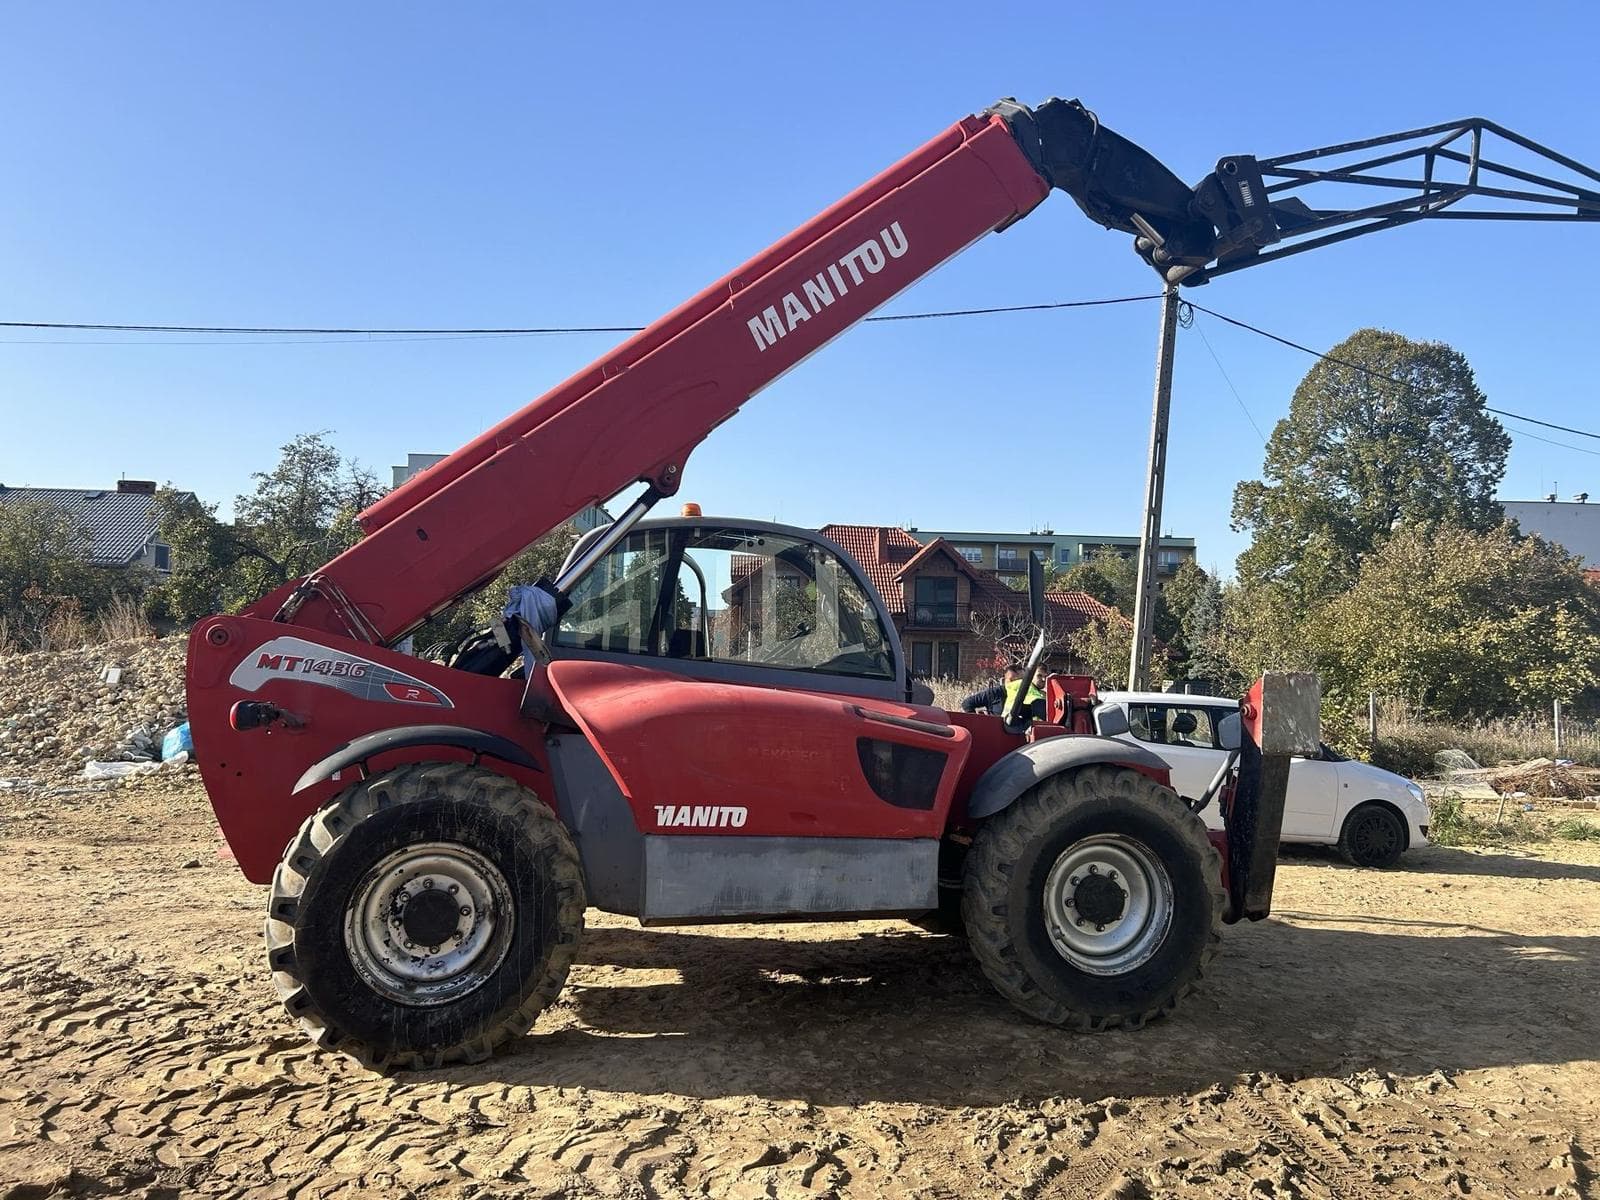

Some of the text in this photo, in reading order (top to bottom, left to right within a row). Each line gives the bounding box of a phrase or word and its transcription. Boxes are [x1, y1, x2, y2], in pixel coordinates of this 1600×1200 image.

[747, 221, 909, 352] MANITOU
[256, 652, 370, 678] MT1436
[406, 688, 420, 700] R
